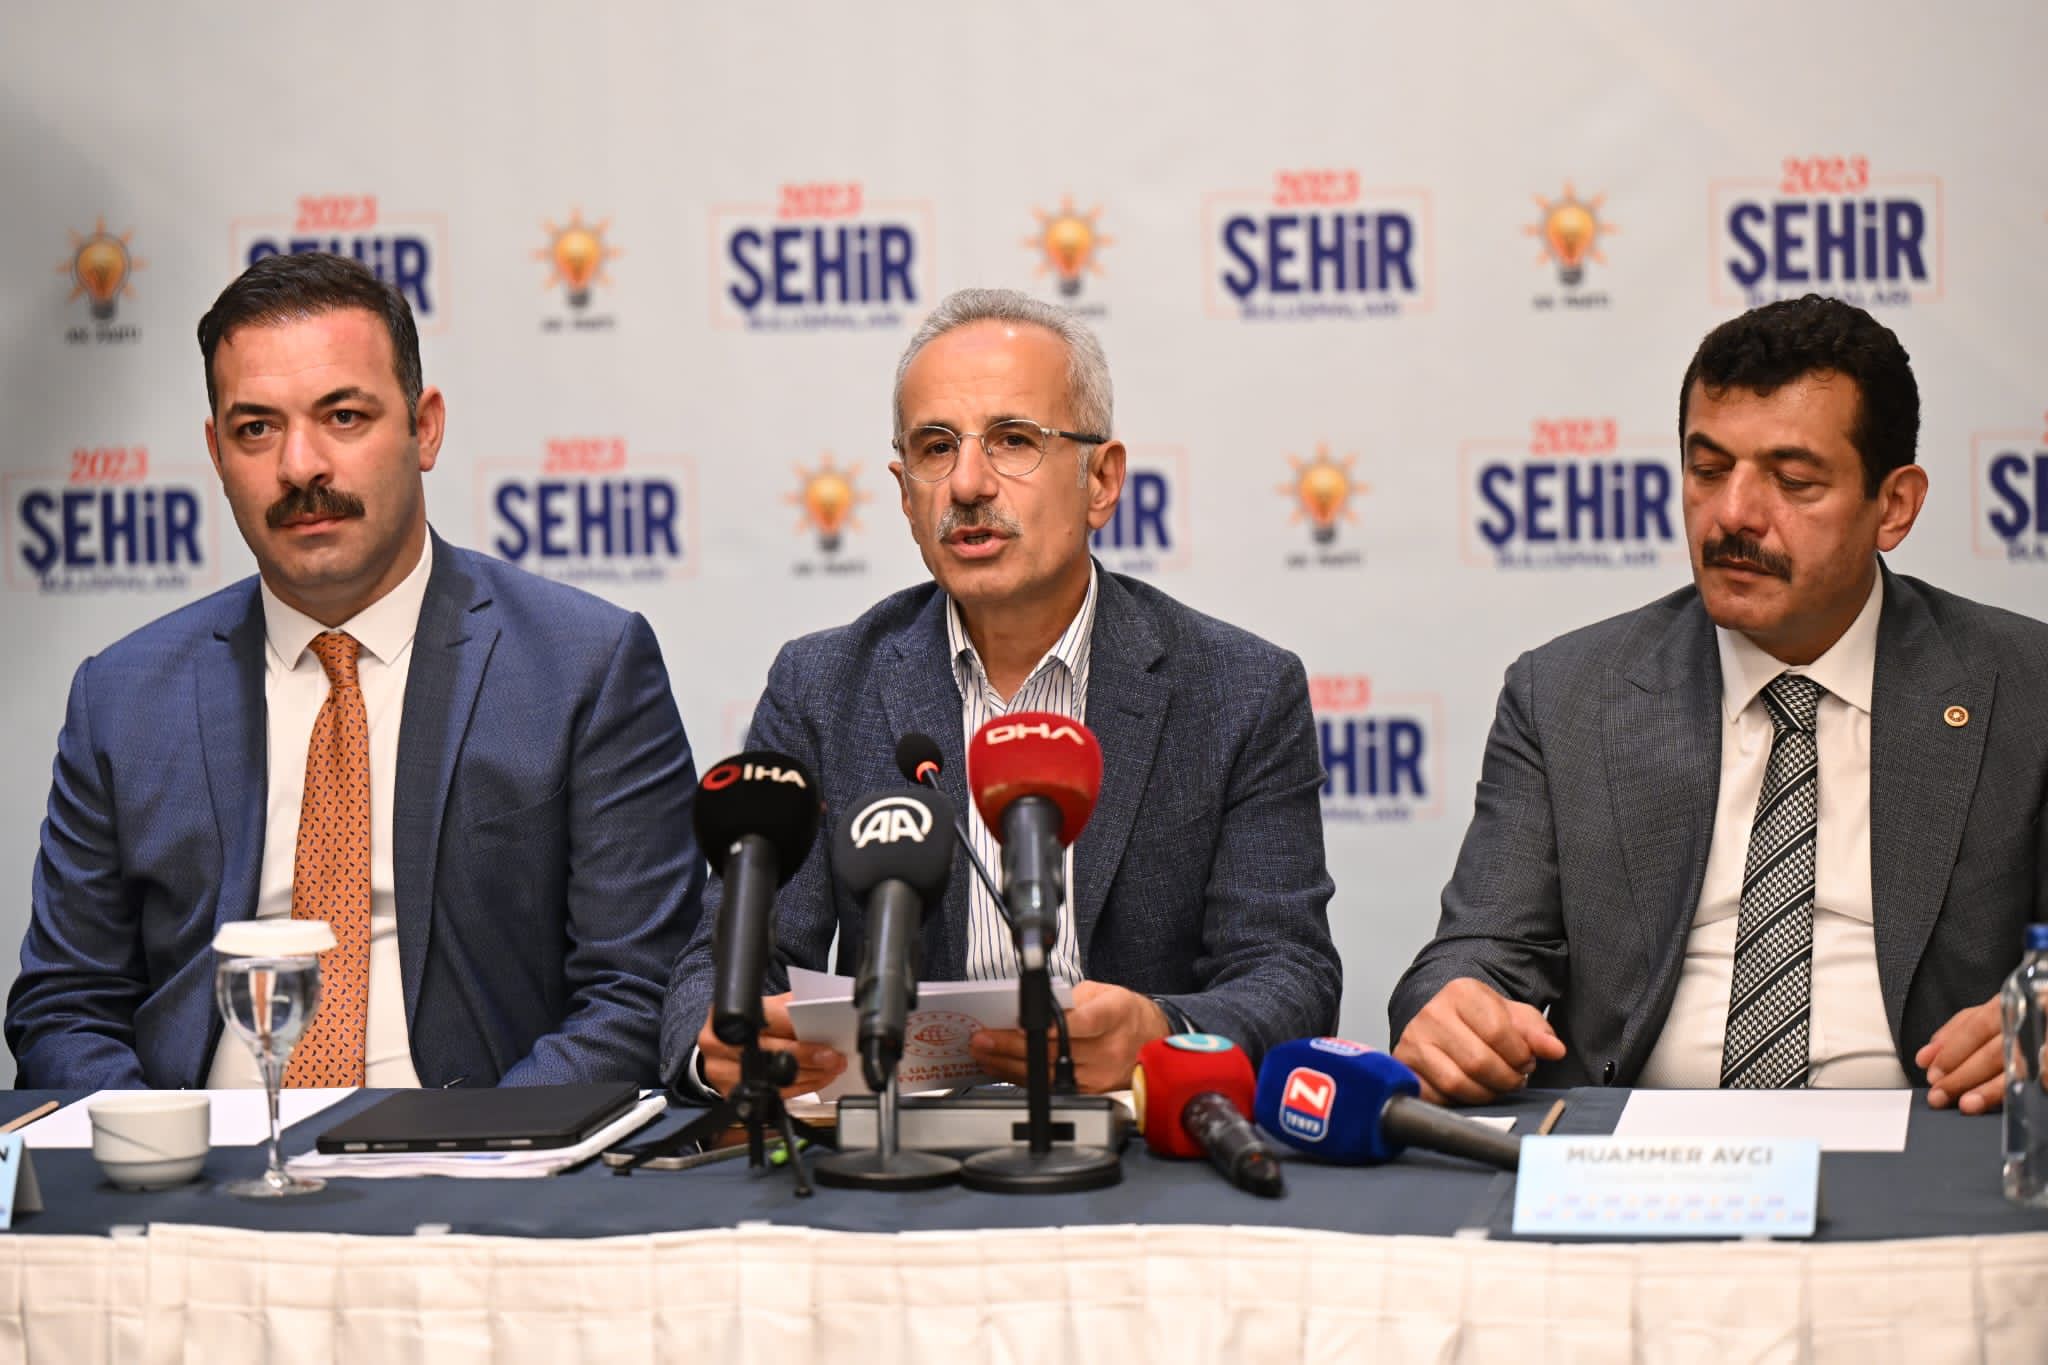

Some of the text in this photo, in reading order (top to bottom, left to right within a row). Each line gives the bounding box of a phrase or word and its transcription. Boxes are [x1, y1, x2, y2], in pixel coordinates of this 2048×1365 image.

[1780, 156, 1870, 195] 2023
[986, 722, 1085, 746] DHA
[1566, 1146, 1701, 1165] MUAMMER
